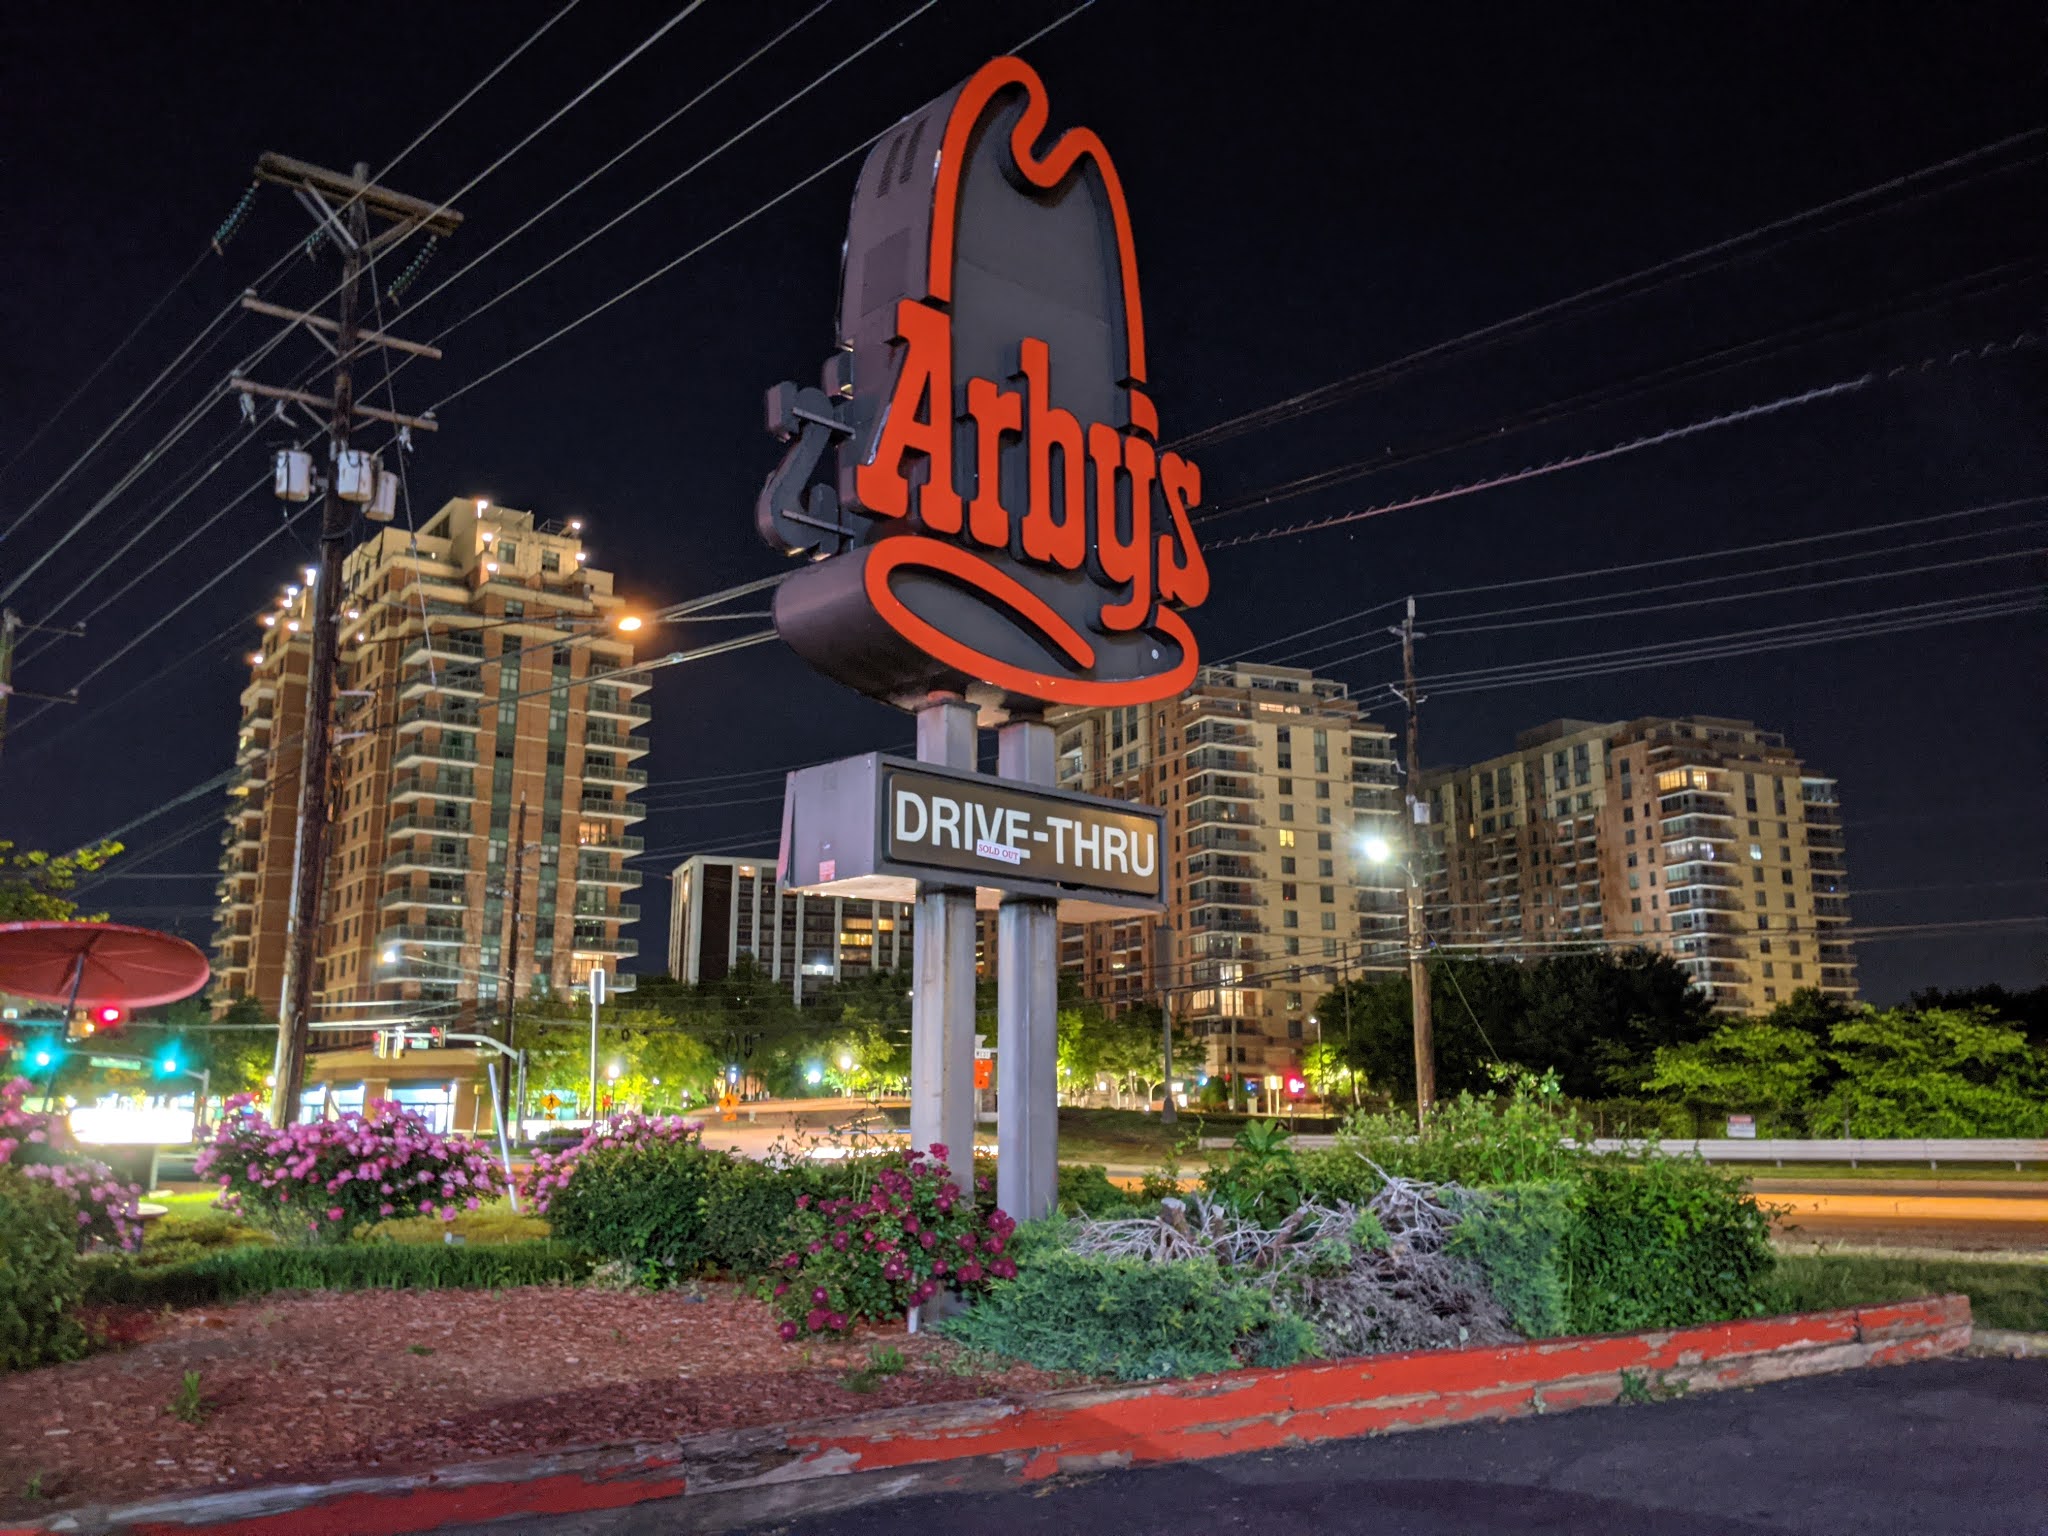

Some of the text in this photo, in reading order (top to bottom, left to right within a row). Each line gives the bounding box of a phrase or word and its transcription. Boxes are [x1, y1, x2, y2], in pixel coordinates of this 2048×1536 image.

[855, 297, 1210, 632] Arby's
[896, 790, 1155, 878] DRIVE-THRU
[978, 843, 1018, 860] SOLD OUT
